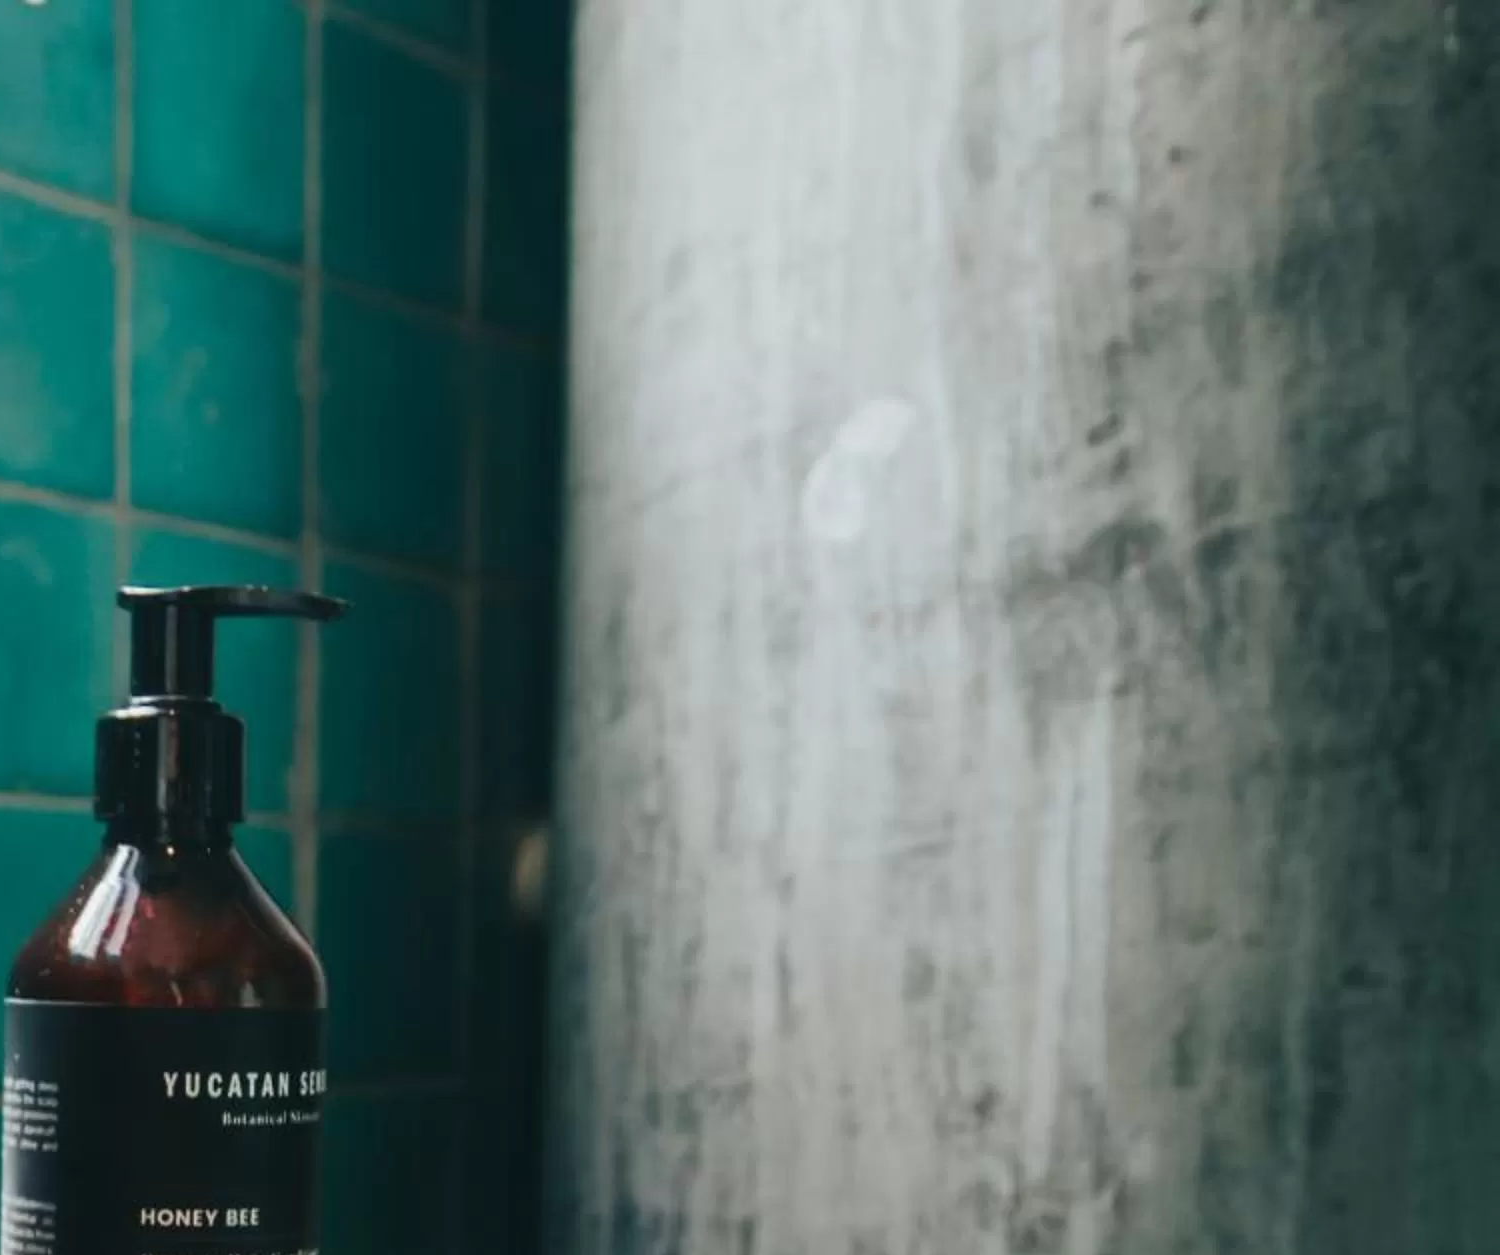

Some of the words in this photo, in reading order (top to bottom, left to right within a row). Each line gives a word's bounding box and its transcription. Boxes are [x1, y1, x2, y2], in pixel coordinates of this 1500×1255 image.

[163, 1070, 289, 1098] YUCATAN
[221, 1110, 287, 1126] Botanical
[140, 1209, 219, 1227] HONEY
[226, 1208, 261, 1226] BEE
